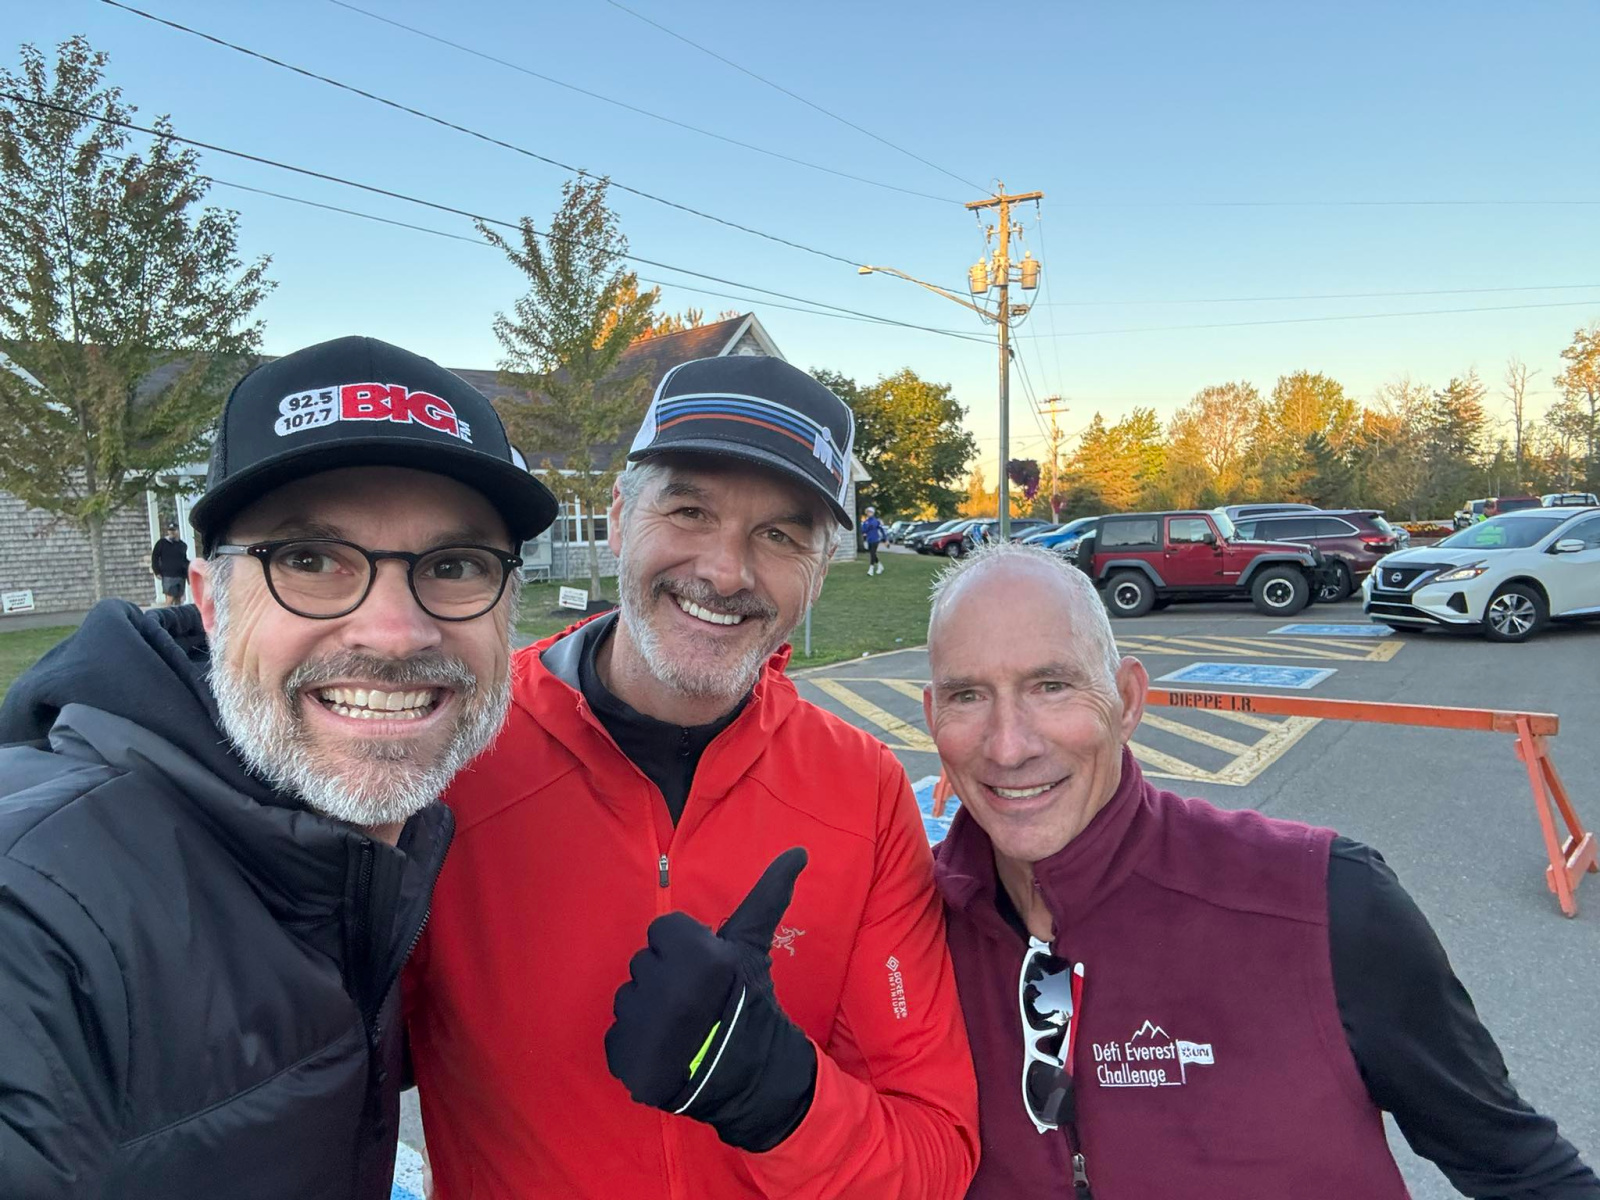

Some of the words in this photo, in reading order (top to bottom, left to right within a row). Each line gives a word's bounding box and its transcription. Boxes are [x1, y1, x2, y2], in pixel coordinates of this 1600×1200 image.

[289, 391, 332, 411] 92.5
[340, 383, 460, 437] BIG
[283, 408, 332, 430] 107.7
[458, 420, 473, 444] FM
[1169, 692, 1222, 709] DIEPPE
[1092, 1041, 1122, 1061] Défi
[1125, 1042, 1176, 1061] Everest
[1097, 1063, 1166, 1088] Challenge
